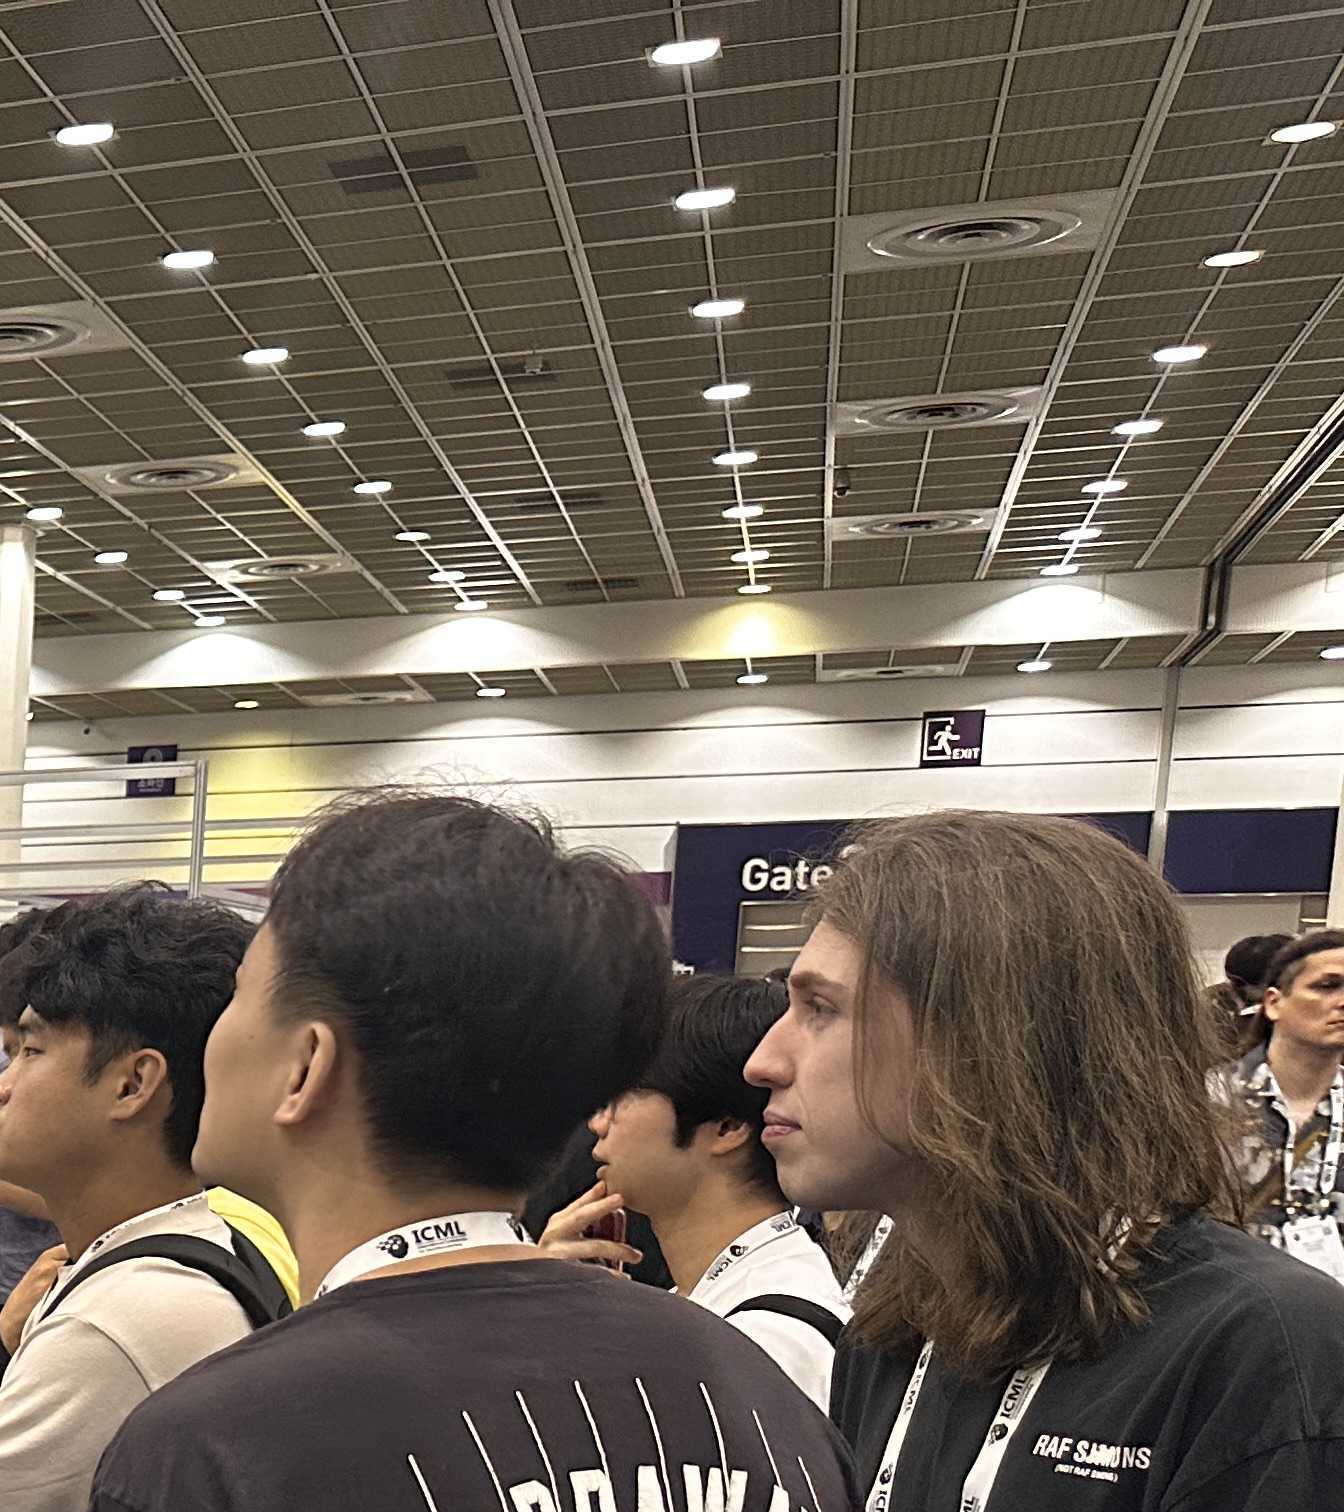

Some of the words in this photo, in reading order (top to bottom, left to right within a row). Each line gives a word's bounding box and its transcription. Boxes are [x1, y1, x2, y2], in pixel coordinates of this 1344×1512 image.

[952, 747, 980, 760] EXIT
[741, 858, 834, 892] Gate
[411, 1220, 467, 1243] ICML
[1000, 1374, 1029, 1419] ICML
[1032, 1434, 1073, 1459] RAF
[1073, 1440, 1151, 1469] SIMONS
